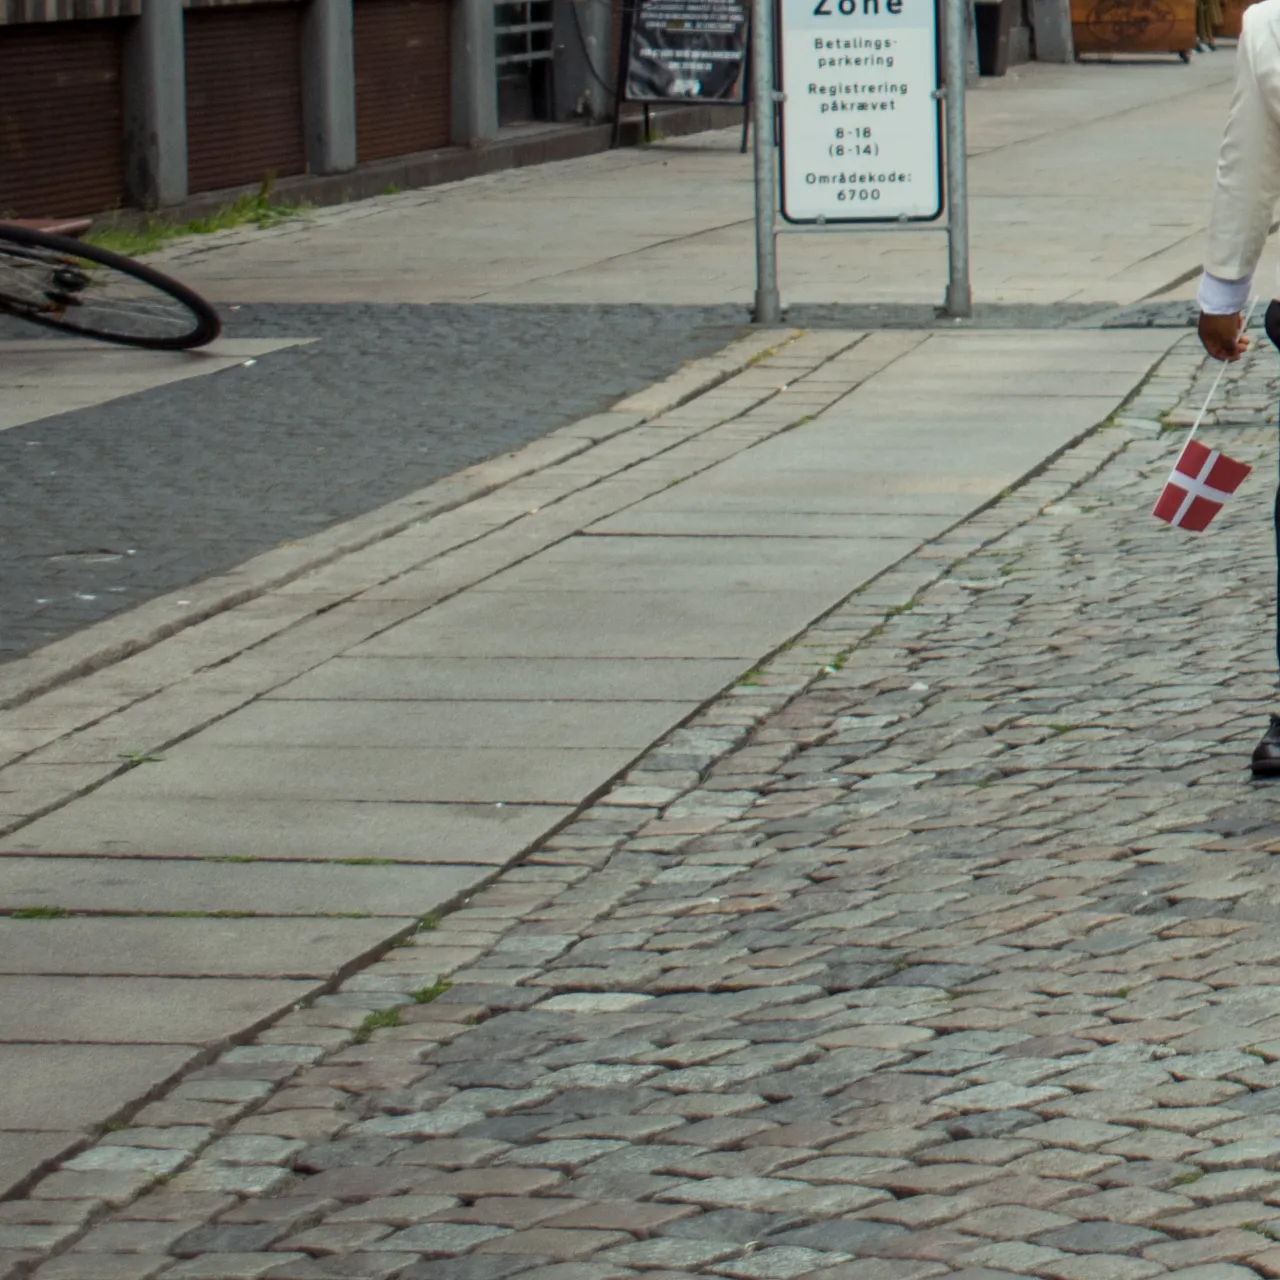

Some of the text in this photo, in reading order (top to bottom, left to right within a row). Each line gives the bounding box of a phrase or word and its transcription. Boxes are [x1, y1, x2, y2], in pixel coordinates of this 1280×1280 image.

[813, 37, 898, 52] Betalings-
[817, 55, 895, 68] parkering
[807, 82, 909, 96] Registrering
[819, 99, 896, 114] påkrævet
[804, 171, 912, 185] Områdekode:
[836, 189, 881, 202] 6700
